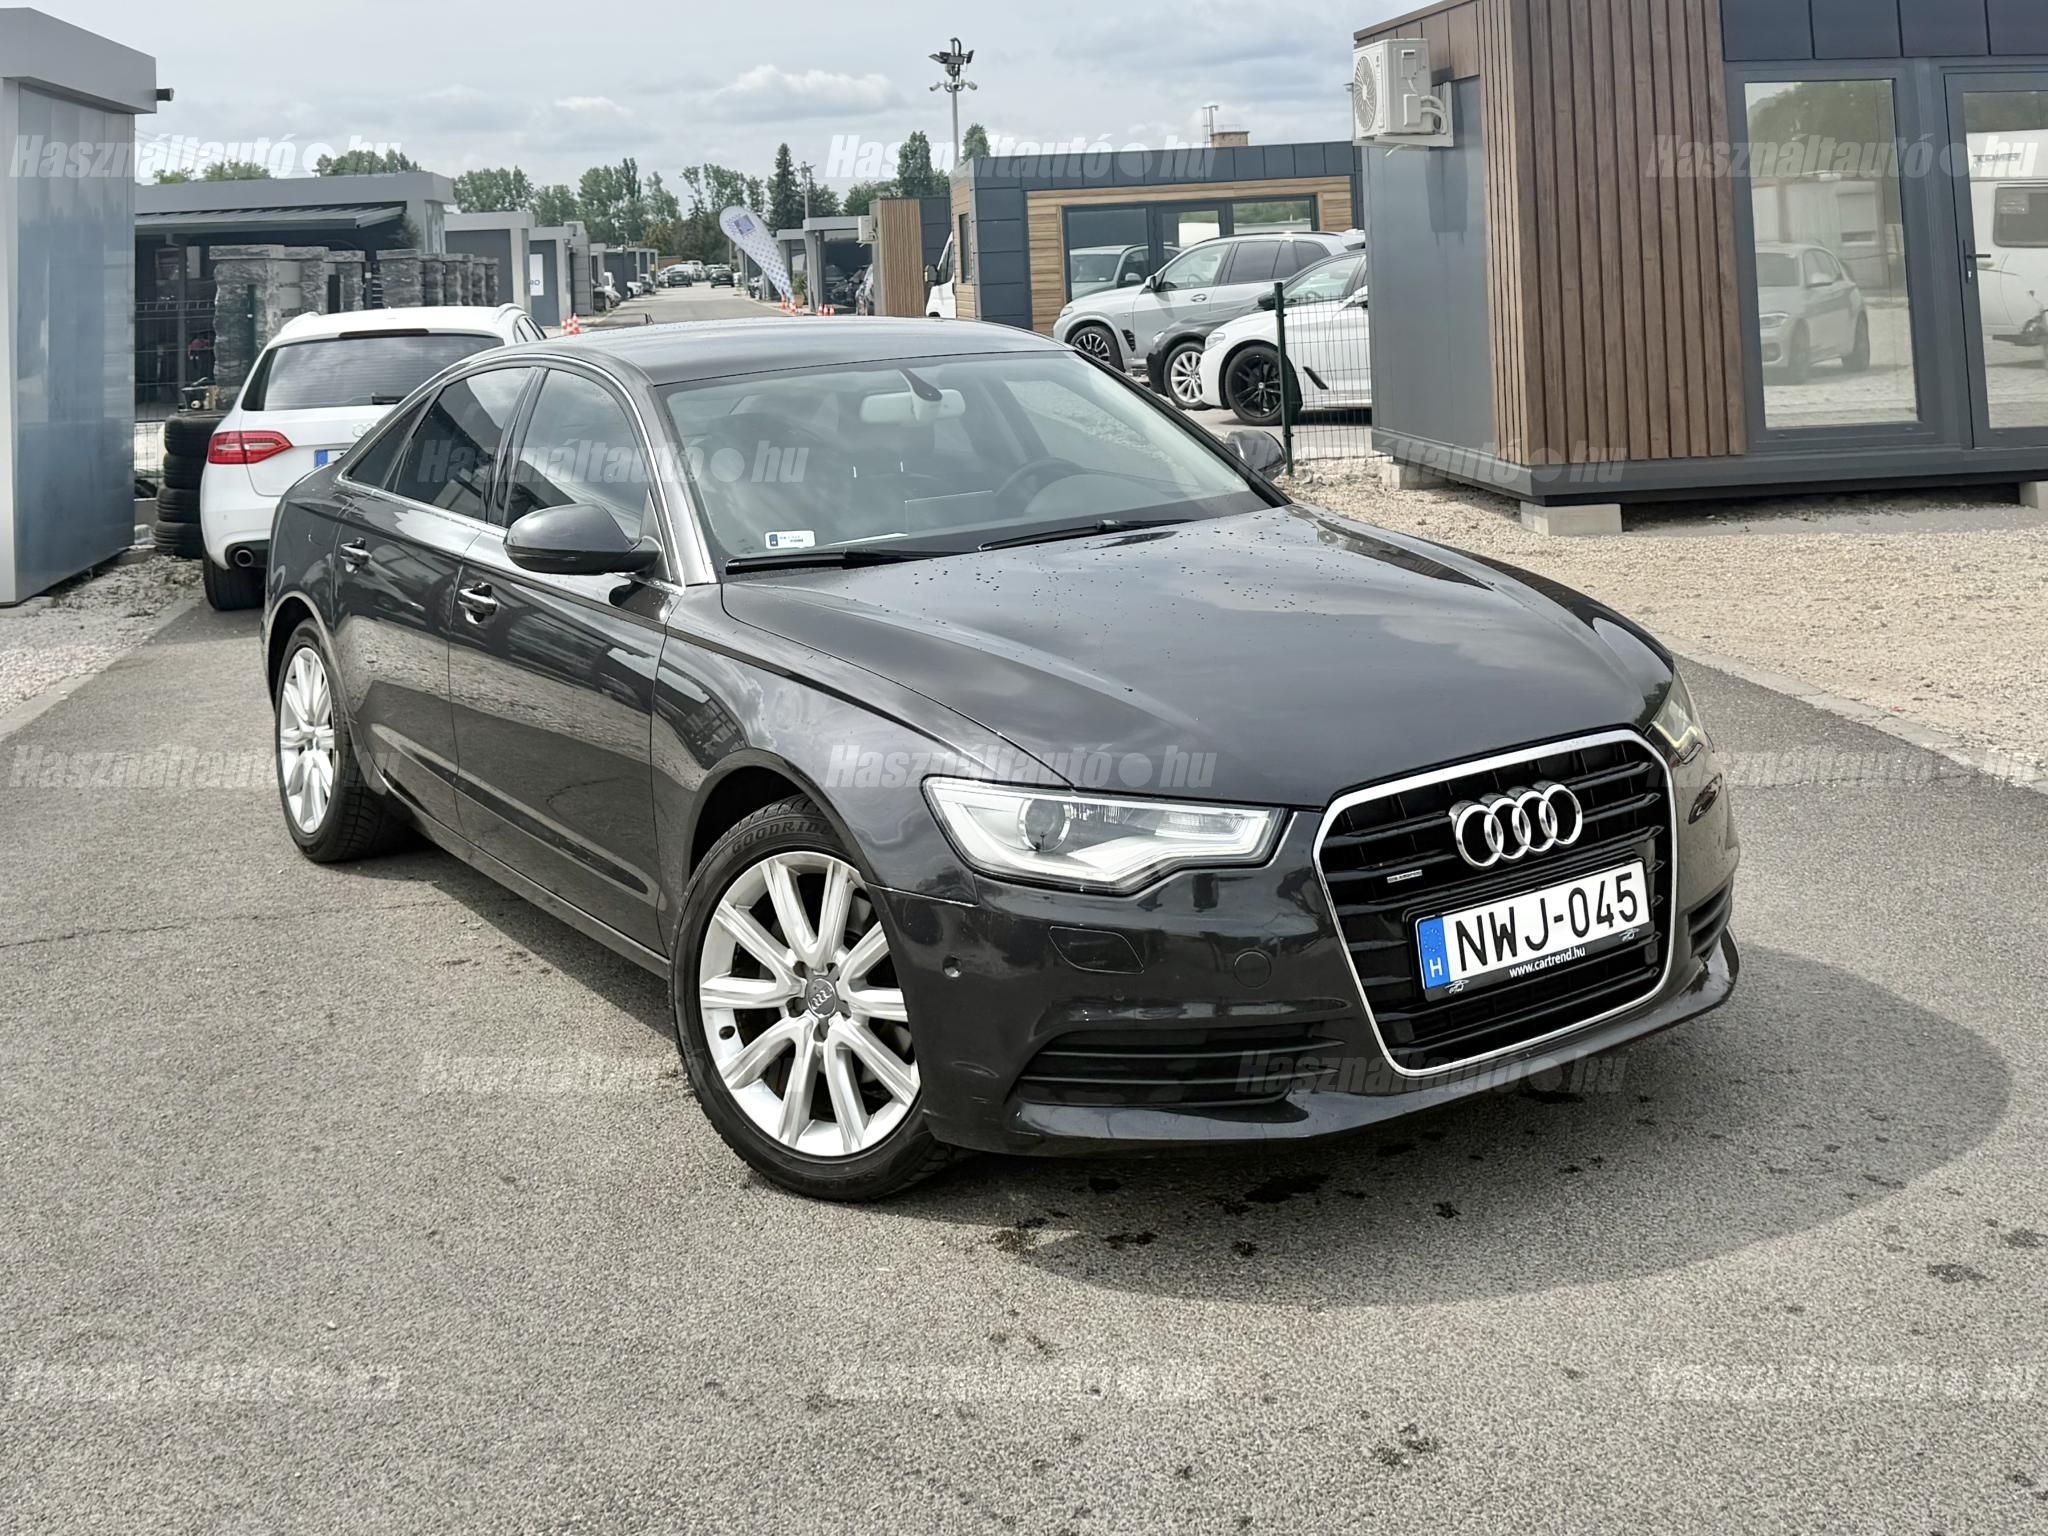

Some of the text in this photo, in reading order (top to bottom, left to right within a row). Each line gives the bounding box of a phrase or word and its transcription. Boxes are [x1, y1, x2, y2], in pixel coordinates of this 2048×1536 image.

[1455, 872, 1638, 972] NWJ-045
[1429, 957, 1443, 978] H
[1509, 947, 1586, 978] www.cartrend.hu
